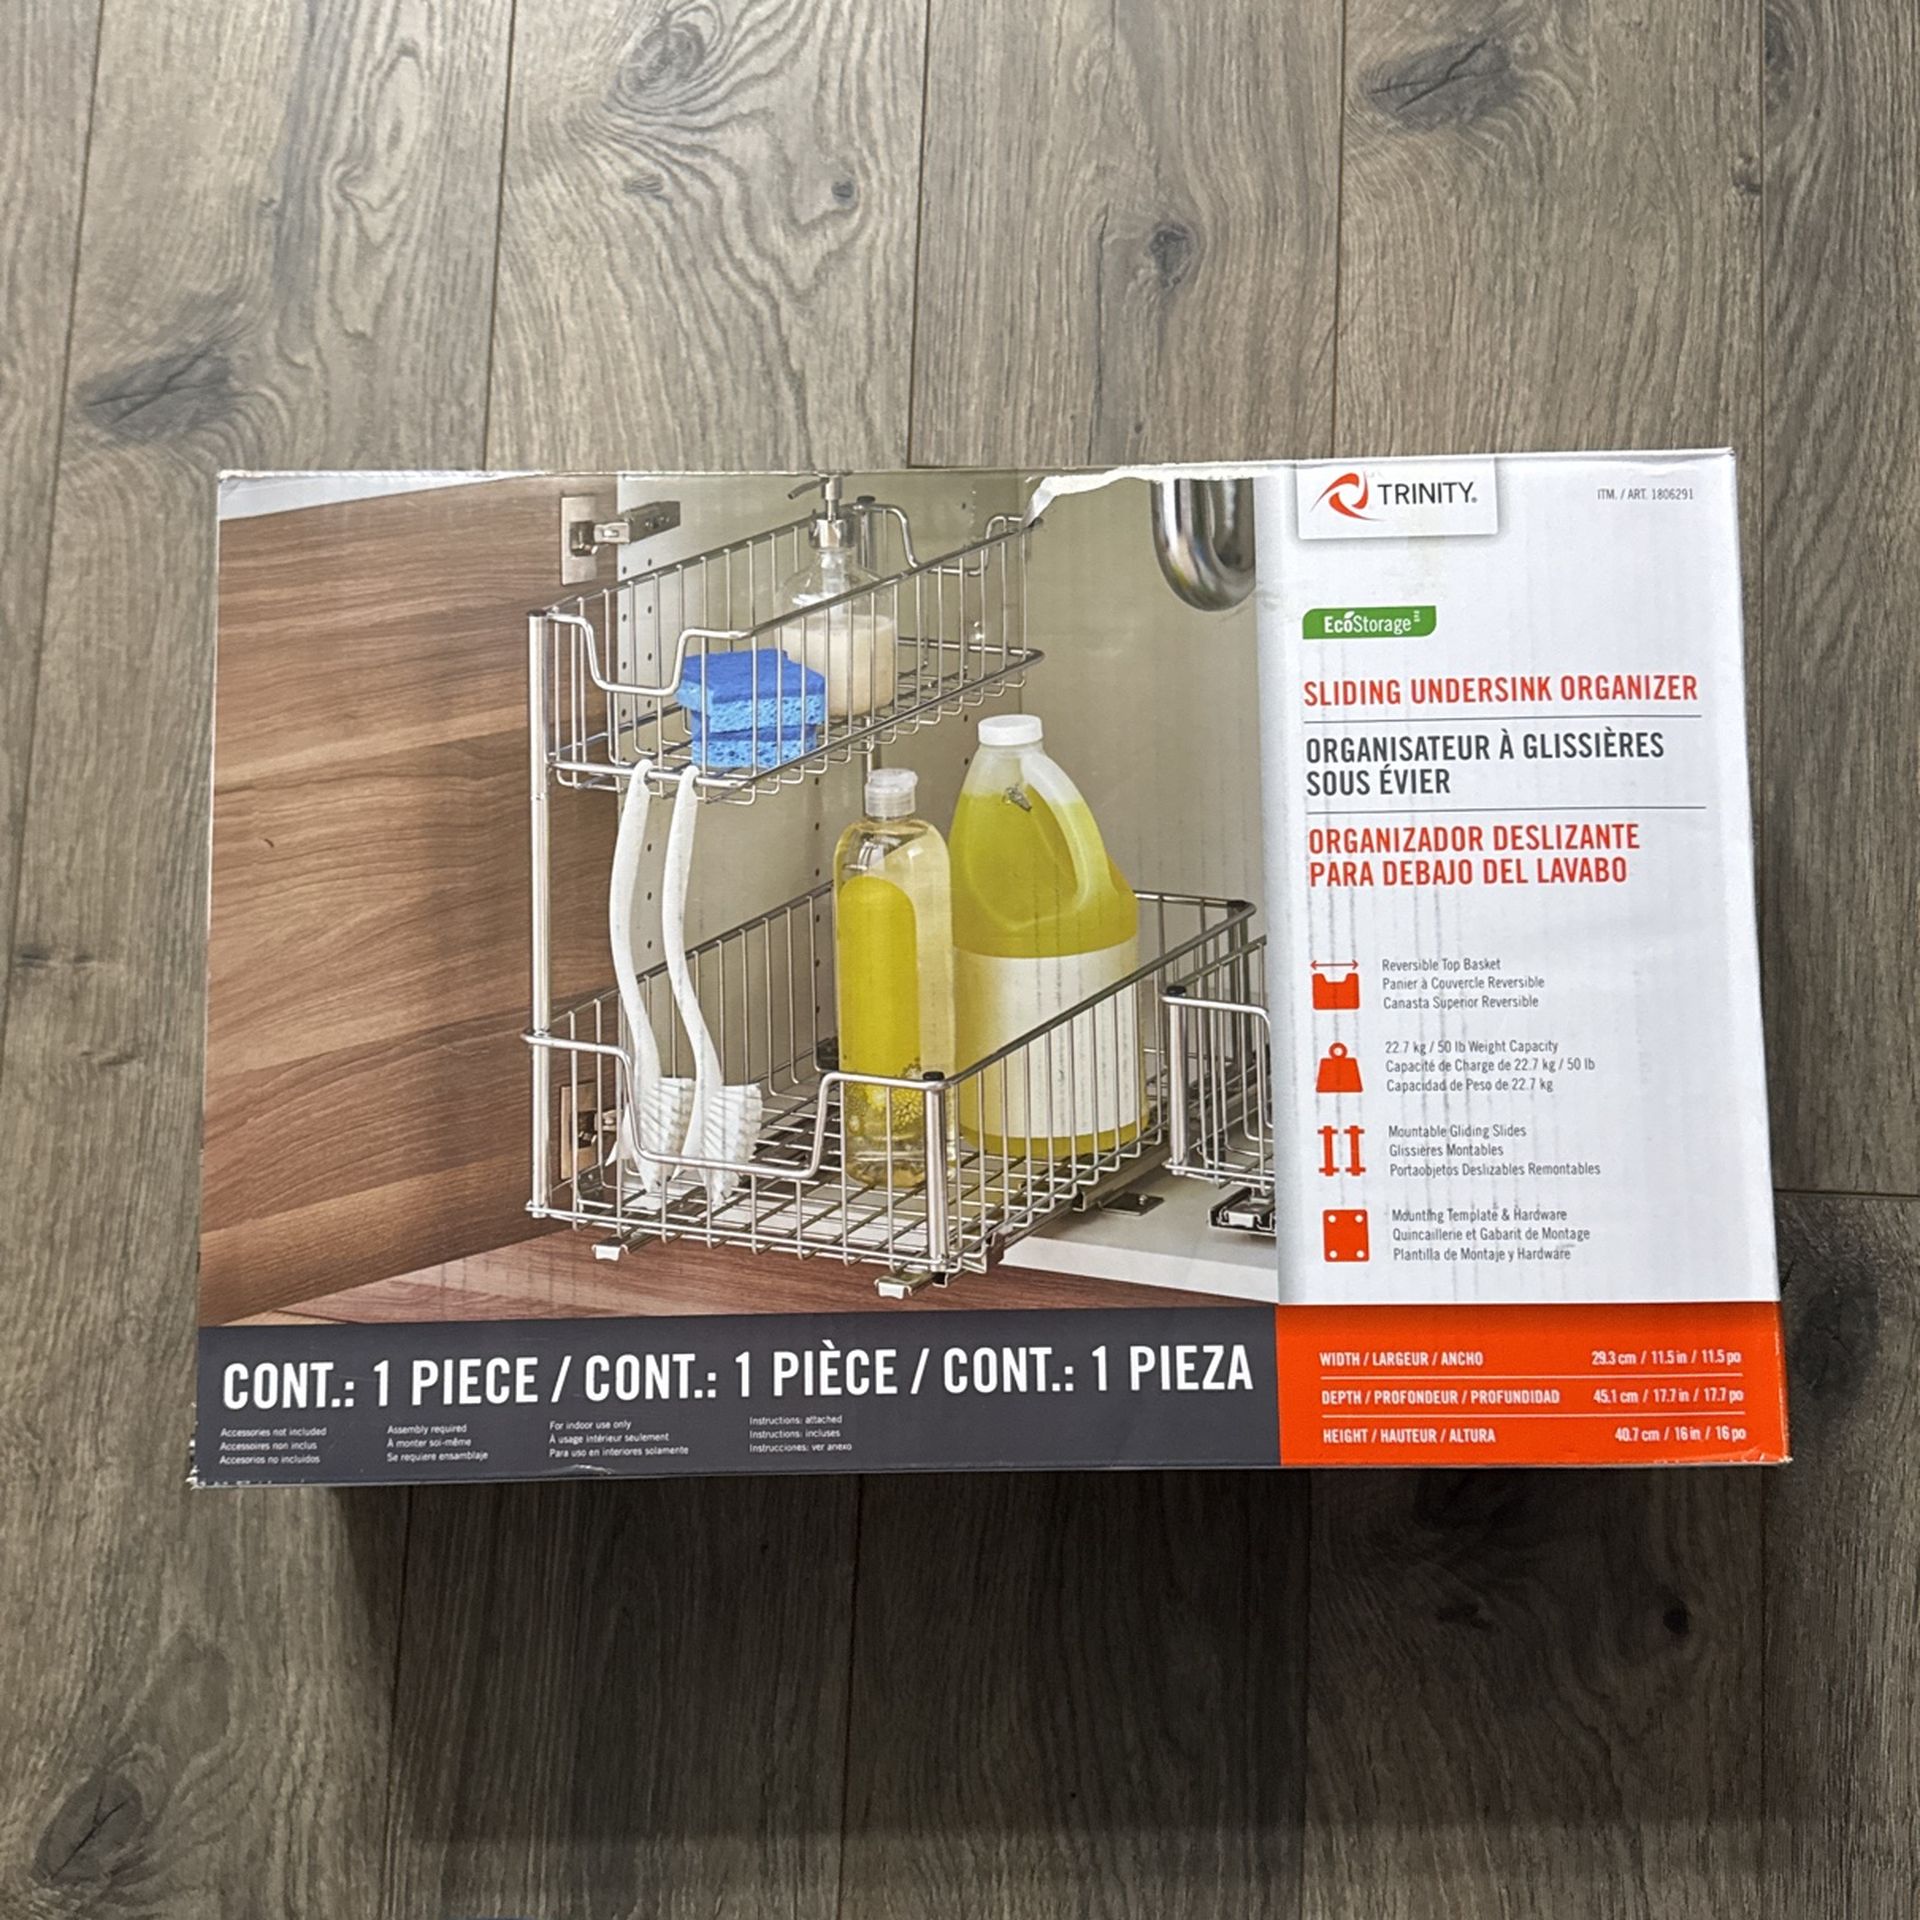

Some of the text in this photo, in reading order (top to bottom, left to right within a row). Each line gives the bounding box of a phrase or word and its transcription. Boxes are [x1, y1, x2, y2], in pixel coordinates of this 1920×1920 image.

[1597, 488, 1694, 500] ITM. / ART. 1806291
[1304, 675, 1698, 705] SLIDING UNDERSINK ORGANIZER
[1306, 727, 1664, 763] ORGANISATEUR À GLISSIÈRES
[1307, 764, 1451, 796] SOUS ÉVIER
[1309, 824, 1639, 854] ORGANIZADOR DESLIZANTE
[1310, 857, 1627, 887] PARA DEBAJO DEL LAVABO
[1382, 958, 1501, 972] Reversible Top Basket
[1383, 976, 1545, 990] Panier à Couvercle Reversible
[1384, 996, 1539, 1010] Canasta Superior Reversible
[1385, 1040, 1559, 1055] 22.7 kg / 50 lb Weight Capacity
[1386, 1058, 1595, 1075] Capacité de Charge de 22.7 kg / 50 lb
[1387, 1078, 1553, 1094] Capacidad de Peso de 22.7 kg
[1389, 1124, 1526, 1139] Mountable Gliding Slides
[1446, 1144, 1503, 1156] Montables
[1390, 1163, 1601, 1178] Portaobjetos Deslizables Remontables
[1392, 1208, 1567, 1224] Mounting Template & Hardware
[1393, 1227, 1590, 1241] Quincaillerie et Gabarit de Montage
[1394, 1247, 1571, 1263] Plantilla de Montaje y Hardware
[1320, 1351, 1483, 1367] WIDTH / LARGEUR / ANCHO
[1592, 1349, 1741, 1365] 29.3 cm / 11.5 in / 11.5 po
[223, 1340, 1254, 1409] CONT.: 1 PIECE / CONT.: 1 PIÈCE / CONT.: 1 PIEZA
[1322, 1389, 1560, 1405] DEPTH / PROFONDEUR / PROFUNDIDAD
[1593, 1387, 1744, 1403] 45.1 cm / 17.7 in / 17.7 po
[549, 1420, 631, 1430] For indoor use only
[805, 1415, 842, 1424] attached
[220, 1428, 270, 1437] Accessories
[289, 1427, 327, 1436] included
[387, 1424, 467, 1434] Assembly required
[1324, 1427, 1495, 1443] HEIGHT / HAUTEUR / ALTURA
[1615, 1426, 1746, 1441] 40.7 cm / 16 in / 16 po
[558, 1435, 583, 1445] usage
[624, 1433, 669, 1442] seulement
[387, 1452, 488, 1462] Se requiere ensamblaje
[549, 1448, 568, 1457] Para
[602, 1448, 642, 1456] interiores
[645, 1447, 689, 1455] solamente
